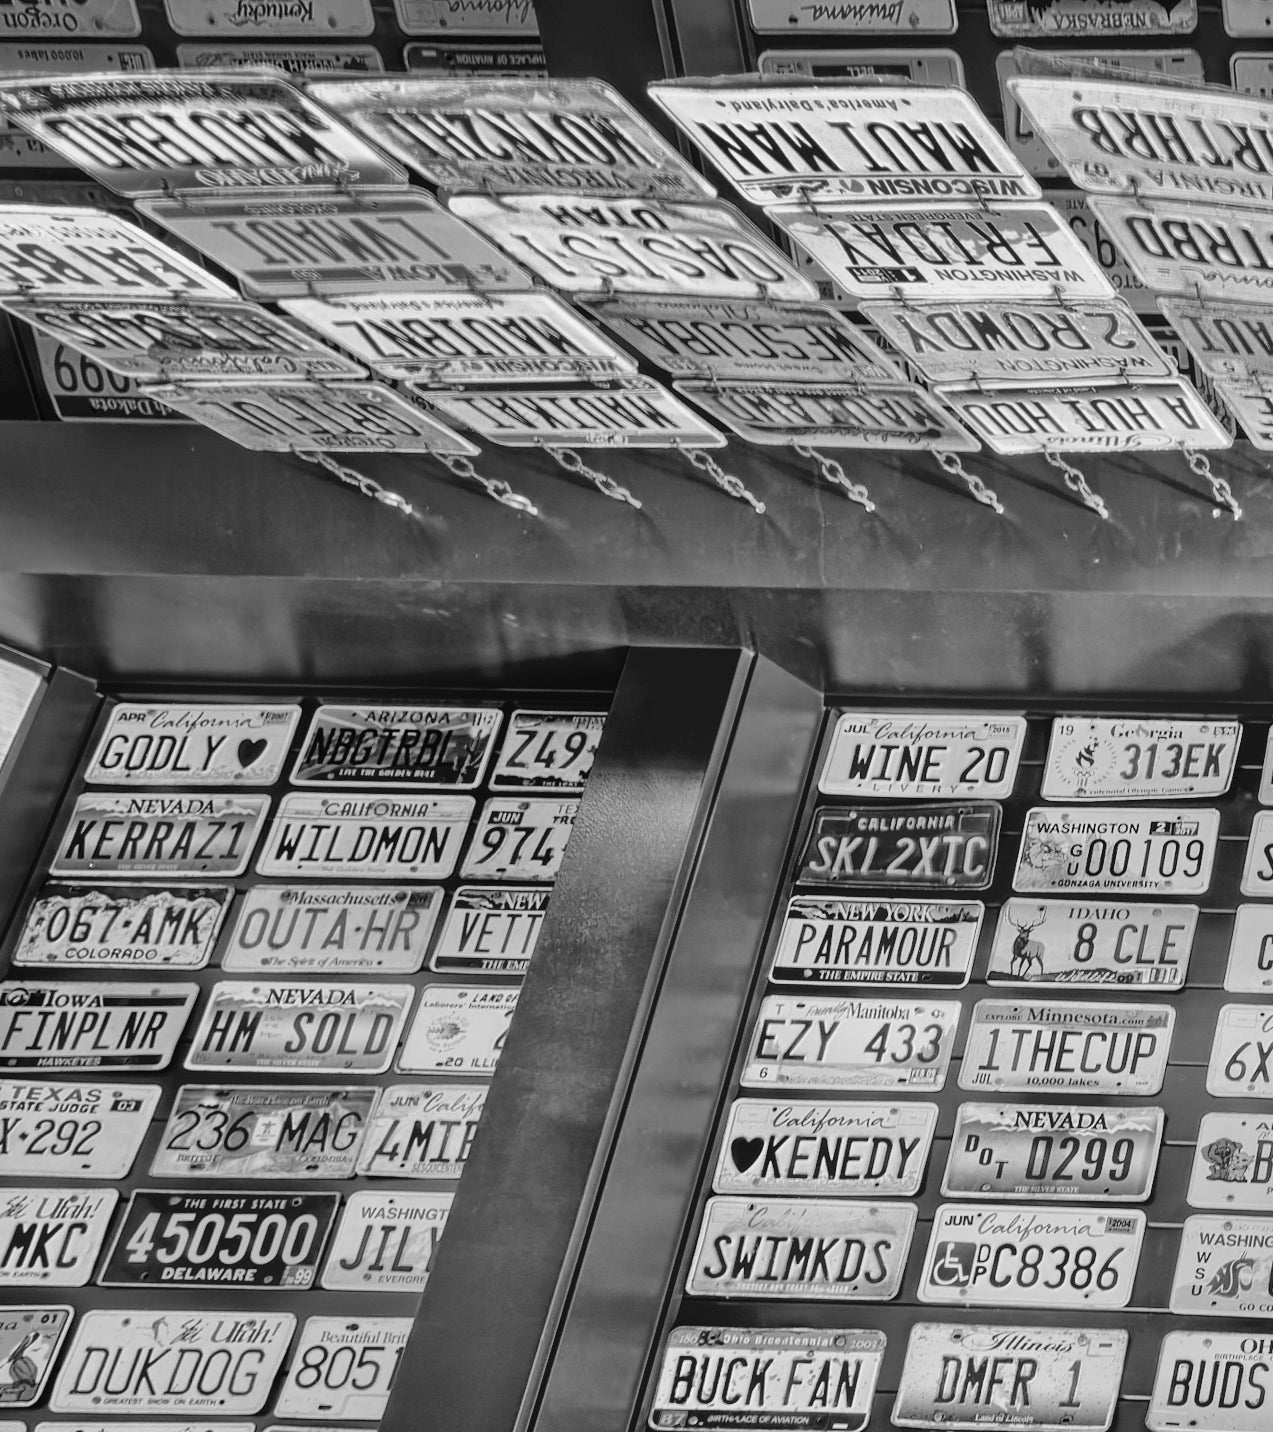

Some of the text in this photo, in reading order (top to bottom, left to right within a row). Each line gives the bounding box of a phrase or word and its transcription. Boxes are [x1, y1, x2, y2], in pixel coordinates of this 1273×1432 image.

[693, 122, 999, 175] MAUI MAN
[867, 179, 1028, 197] WISCONSIN
[822, 221, 1058, 265] FRIDAY
[935, 267, 1083, 282] WASHINGTON
[850, 746, 1010, 784] WINE 20
[1119, 743, 1226, 780] 313EK
[325, 802, 429, 818] CALIFORNIA
[1037, 822, 1140, 835] WASHINGTON
[275, 826, 451, 863] WILDMON
[290, 891, 396, 908] Massachusetts
[832, 903, 935, 922] NEW YORK
[65, 948, 158, 961] COLORADO
[794, 924, 957, 967] PARAMOUR
[2, 1010, 168, 1050] FINPLNR
[204, 1012, 396, 1055] HM SOLD
[167, 1110, 362, 1152] 236 MAG
[1025, 1137, 1136, 1181] 0299
[184, 1198, 287, 1209] THE FIRST STATE
[126, 1213, 318, 1264] 450500
[161, 1267, 256, 1281] DELAWARE
[704, 1235, 888, 1283] SWIMKDS
[669, 1355, 863, 1407] BUCK FAN
